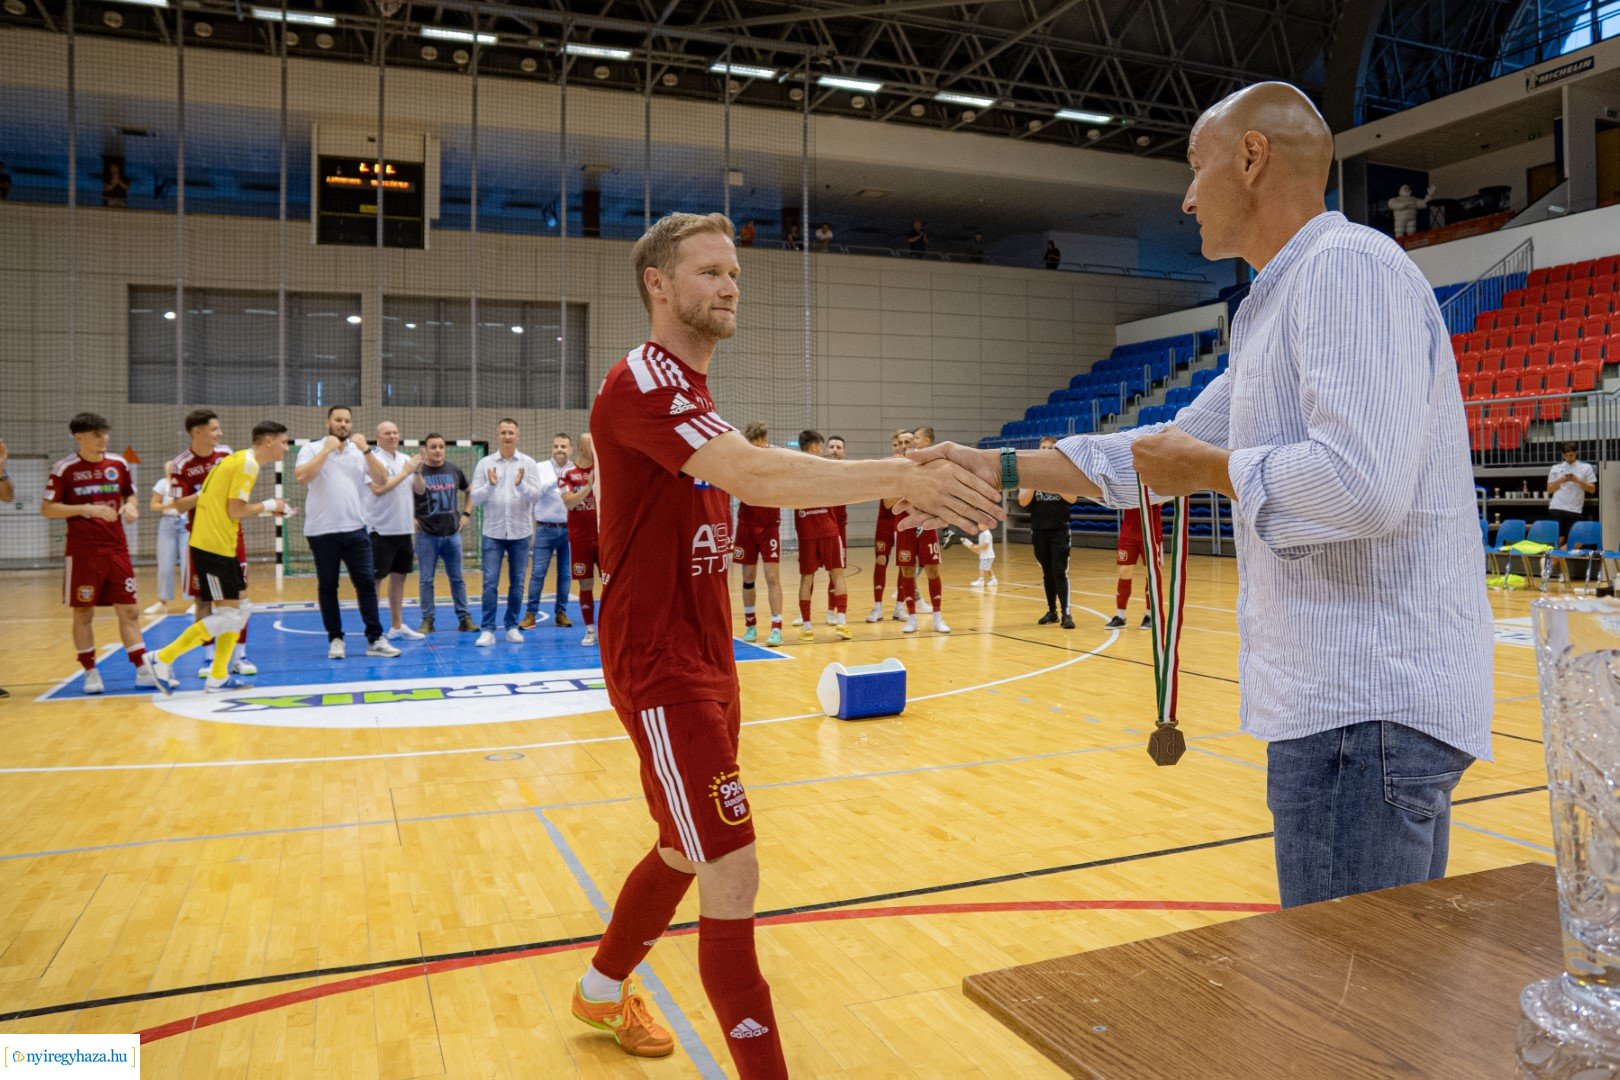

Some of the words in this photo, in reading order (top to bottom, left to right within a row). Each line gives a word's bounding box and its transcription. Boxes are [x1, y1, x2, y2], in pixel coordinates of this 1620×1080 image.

[1539, 59, 1592, 83] MICHELIN
[769, 539, 778, 550] 9
[928, 543, 940, 554] 10
[729, 1025, 769, 1039] adidas
